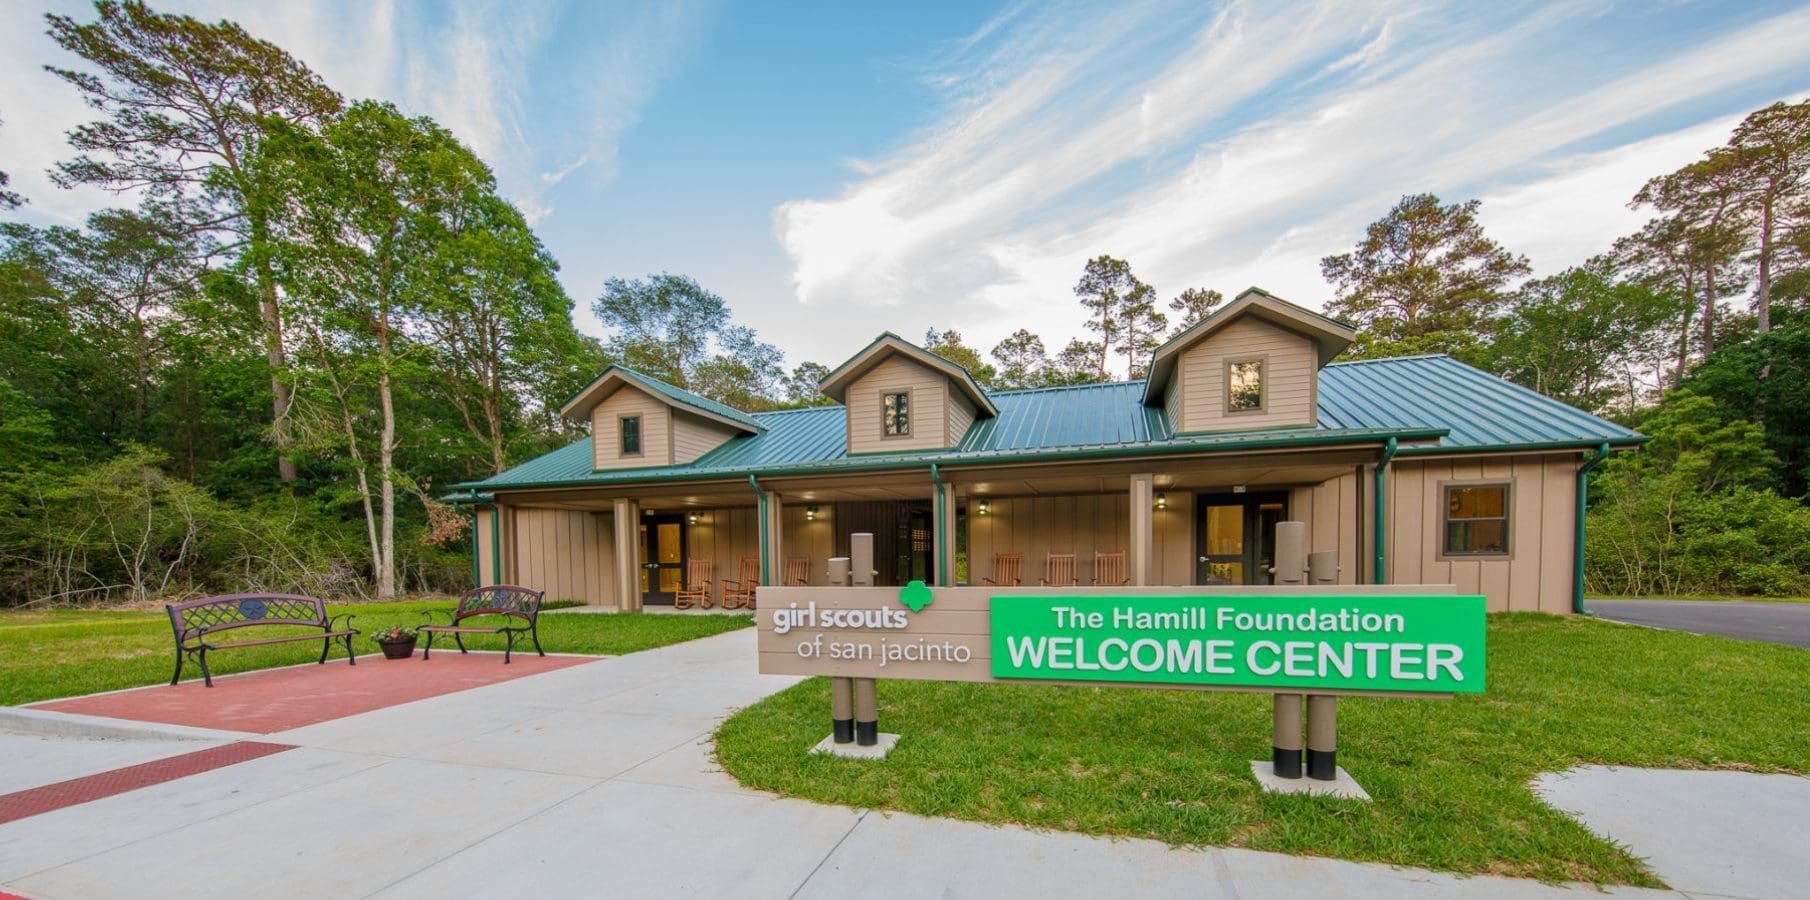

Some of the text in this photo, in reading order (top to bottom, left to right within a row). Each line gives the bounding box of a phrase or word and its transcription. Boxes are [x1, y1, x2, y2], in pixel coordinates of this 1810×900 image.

[773, 601, 908, 634] girl scouts
[1052, 607, 1404, 632] The Hamill Foundation
[797, 634, 971, 667] of san jacinto
[1007, 636, 1464, 681] WELCOME CENTER
